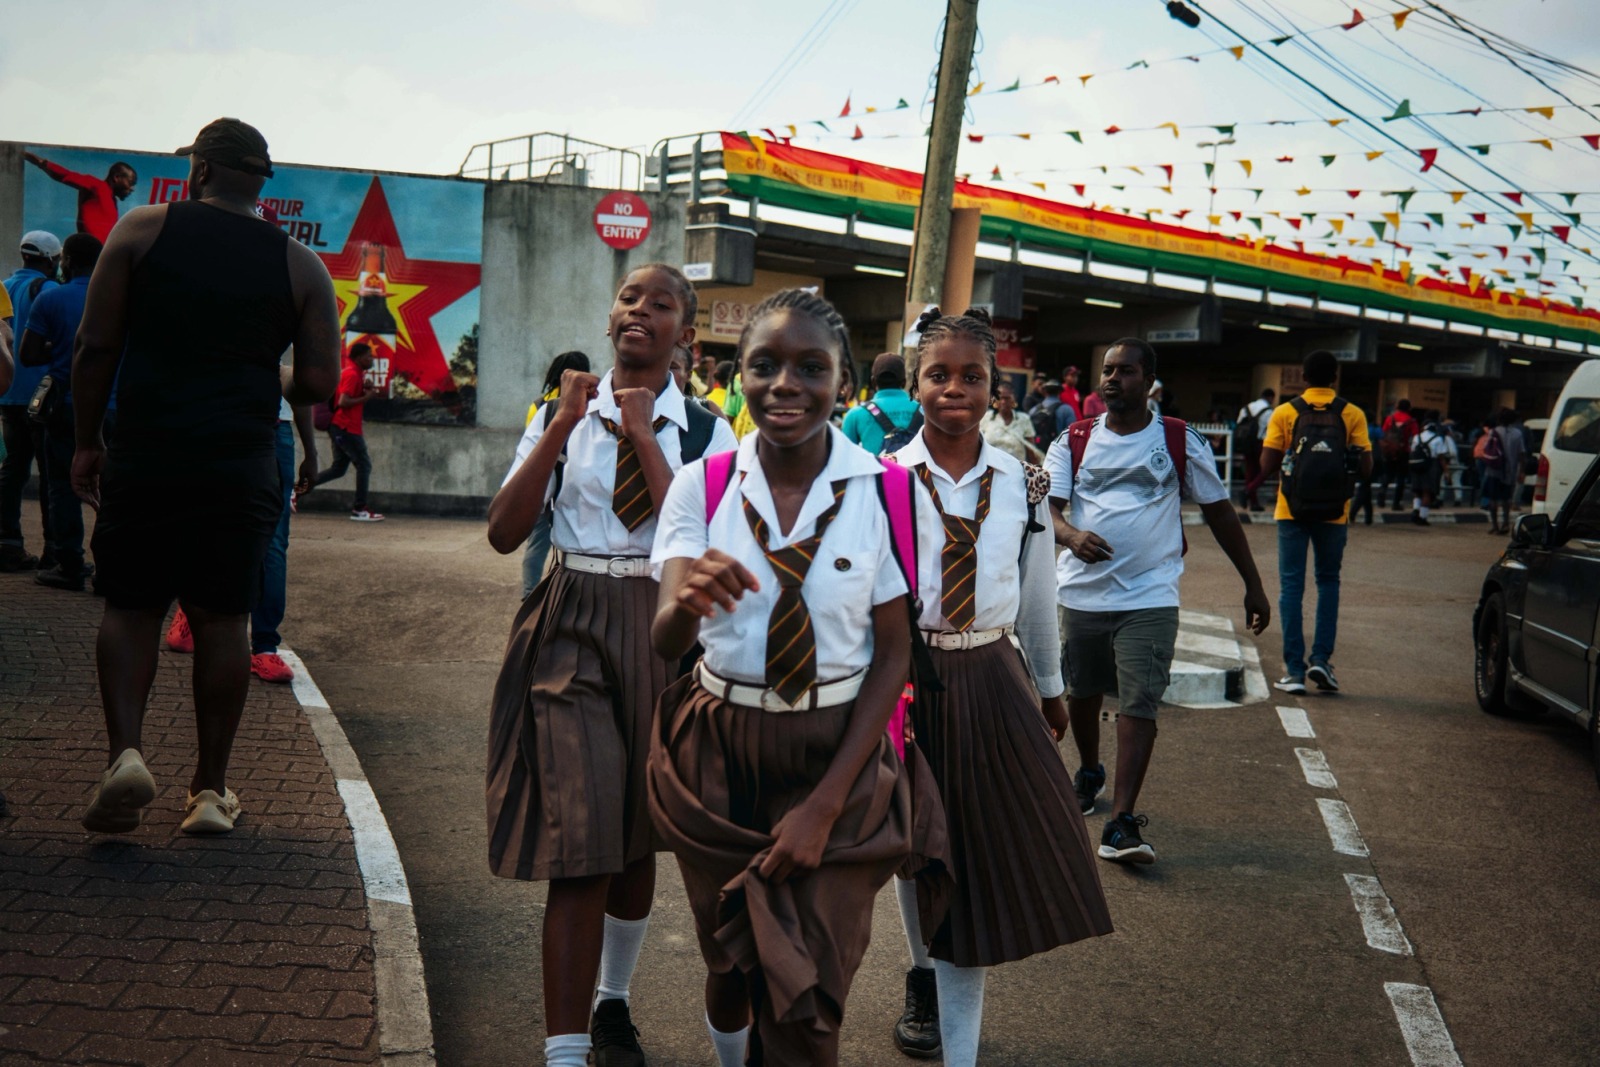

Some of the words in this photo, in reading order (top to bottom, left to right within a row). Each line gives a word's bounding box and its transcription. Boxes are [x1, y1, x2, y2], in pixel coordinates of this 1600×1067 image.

[613, 203, 633, 216] NO
[603, 225, 642, 239] ENTRY
[364, 373, 388, 388] ALT
